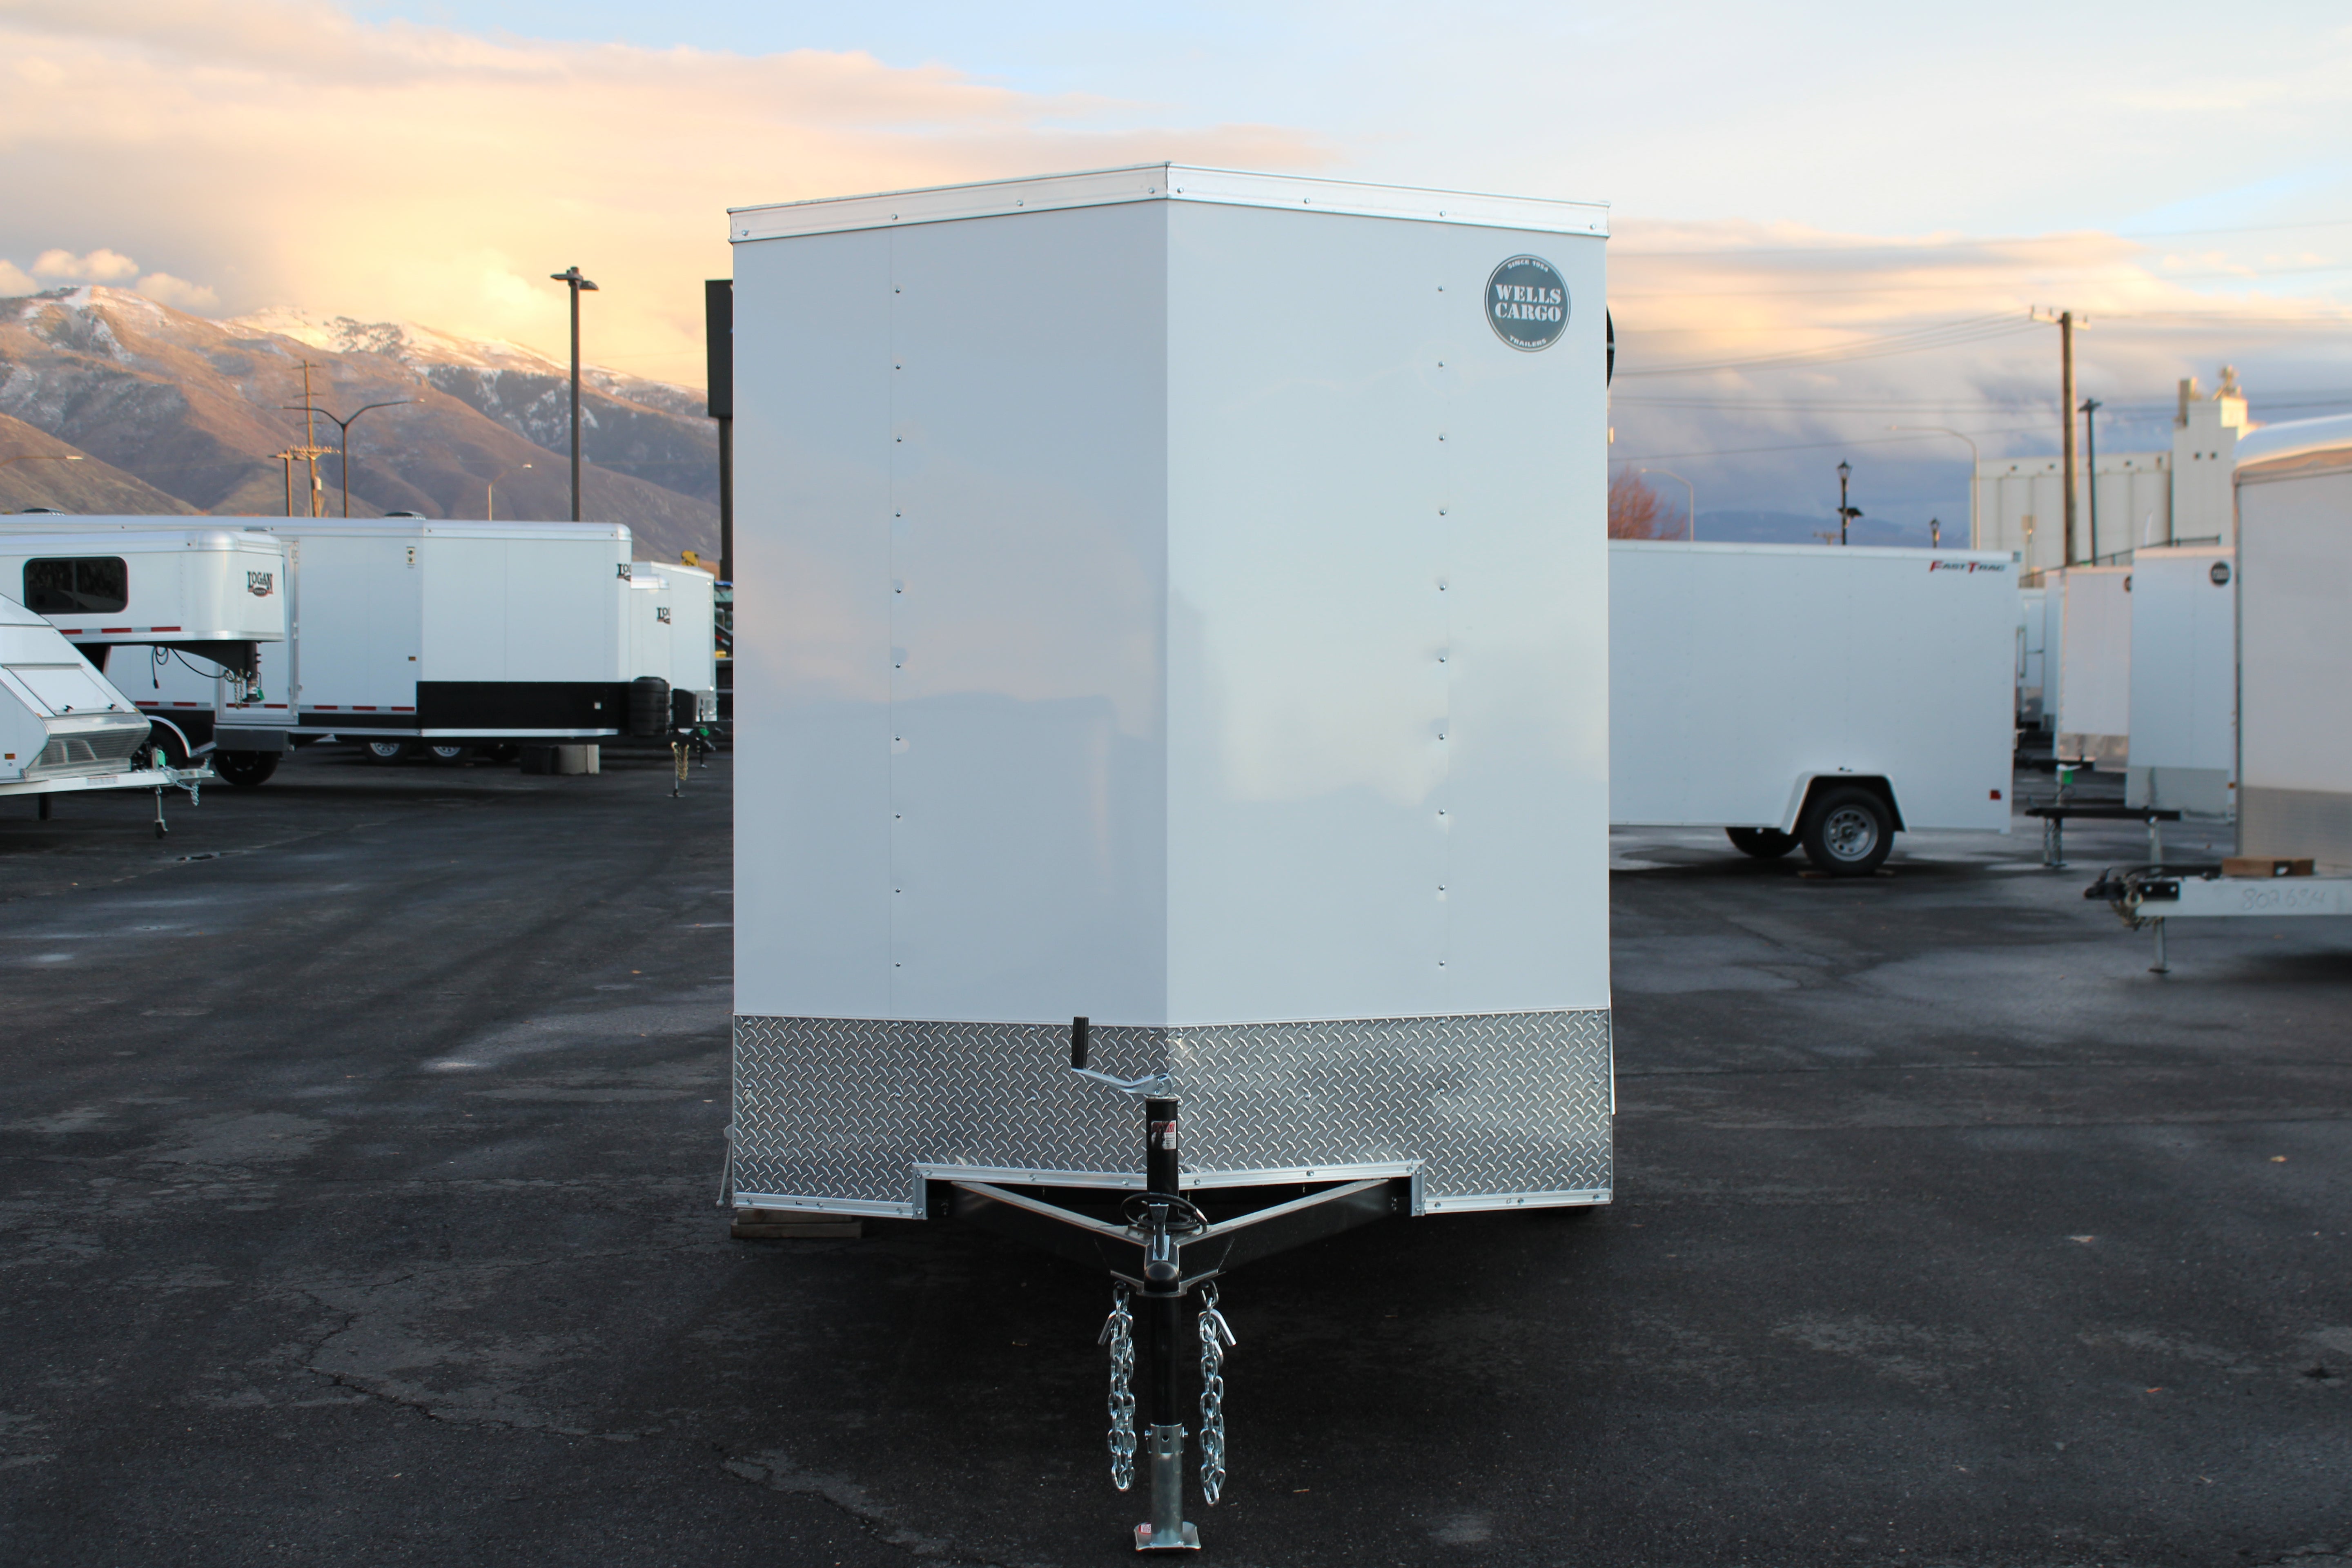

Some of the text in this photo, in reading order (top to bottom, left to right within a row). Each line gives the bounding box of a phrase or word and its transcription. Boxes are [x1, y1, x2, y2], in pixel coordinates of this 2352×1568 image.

[1508, 259, 1530, 270] SINCE
[1495, 284, 1561, 305] WELLS
[1495, 302, 1561, 322] CARGO
[1510, 334, 1547, 347] TRAILERS
[247, 571, 273, 591] LOGAN
